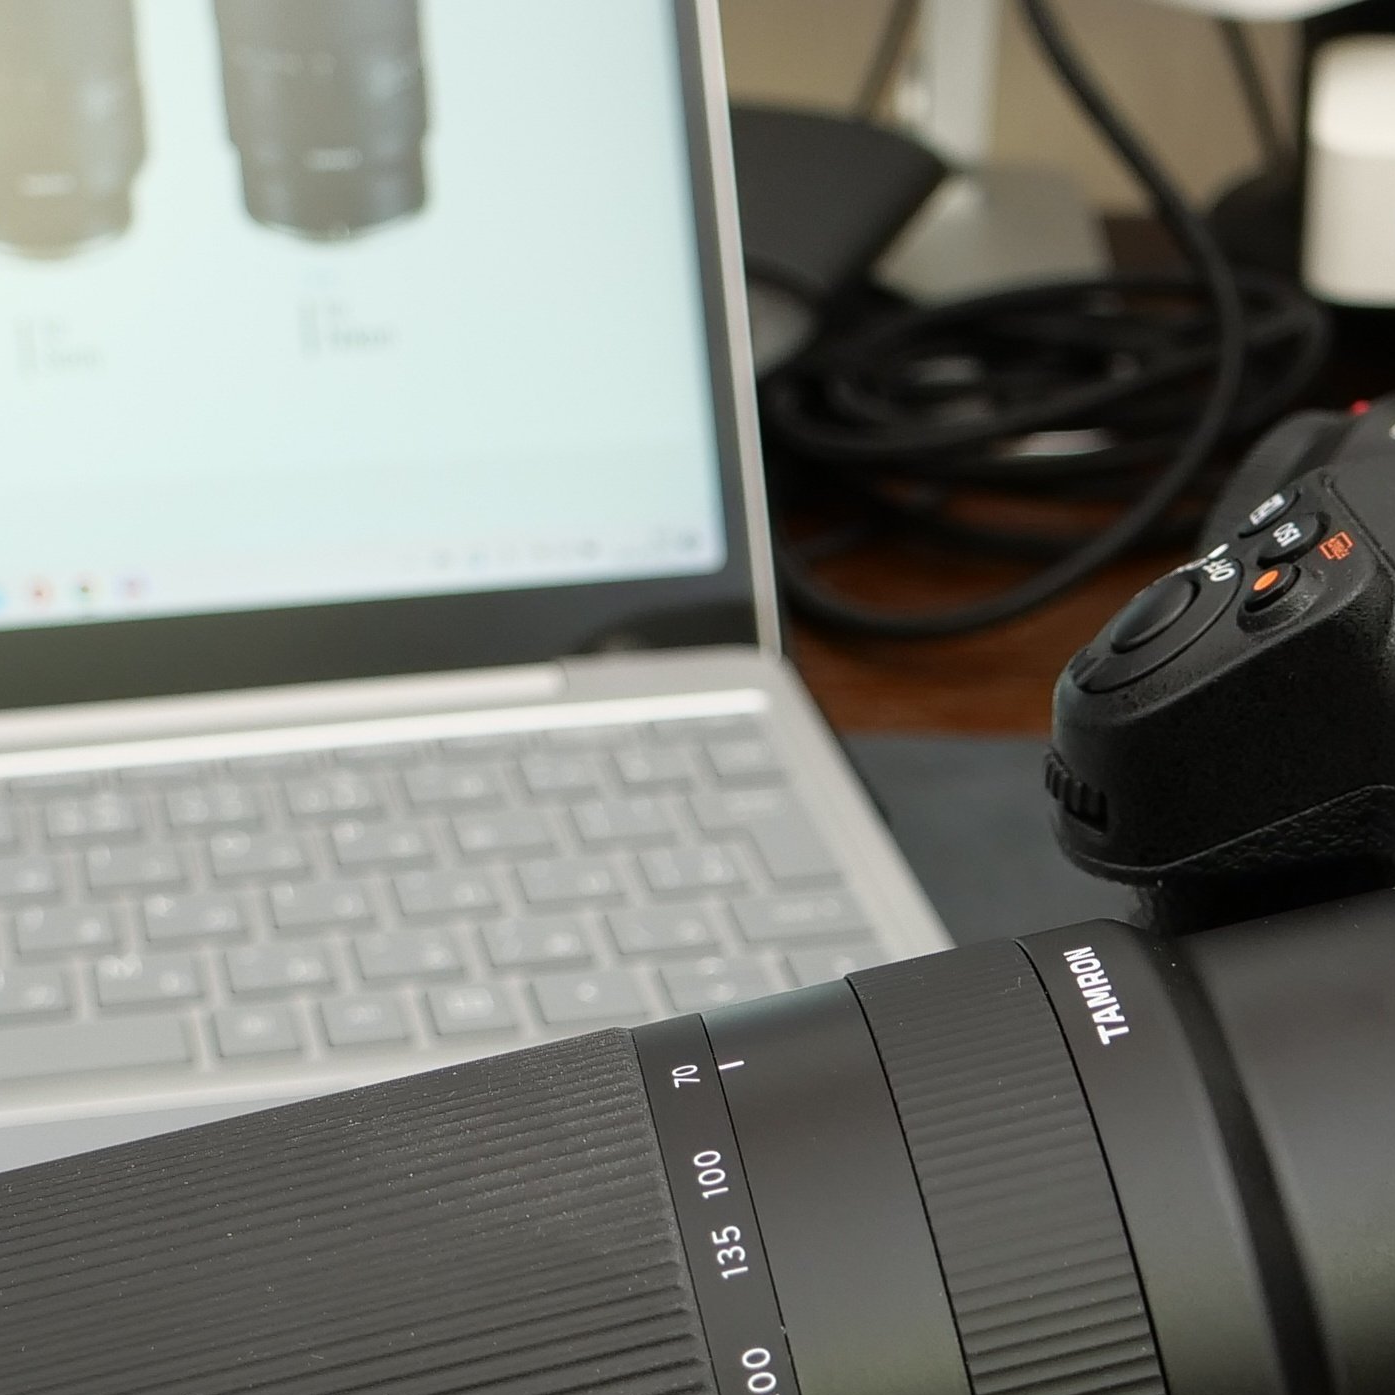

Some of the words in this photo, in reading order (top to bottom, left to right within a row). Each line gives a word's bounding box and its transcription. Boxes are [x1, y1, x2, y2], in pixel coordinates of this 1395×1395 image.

[1272, 521, 1303, 548] ISO
[1062, 945, 1130, 1046] TAMRON
[671, 1064, 701, 1089] 70
[693, 1150, 730, 1199] 100
[711, 1225, 749, 1280] 135
